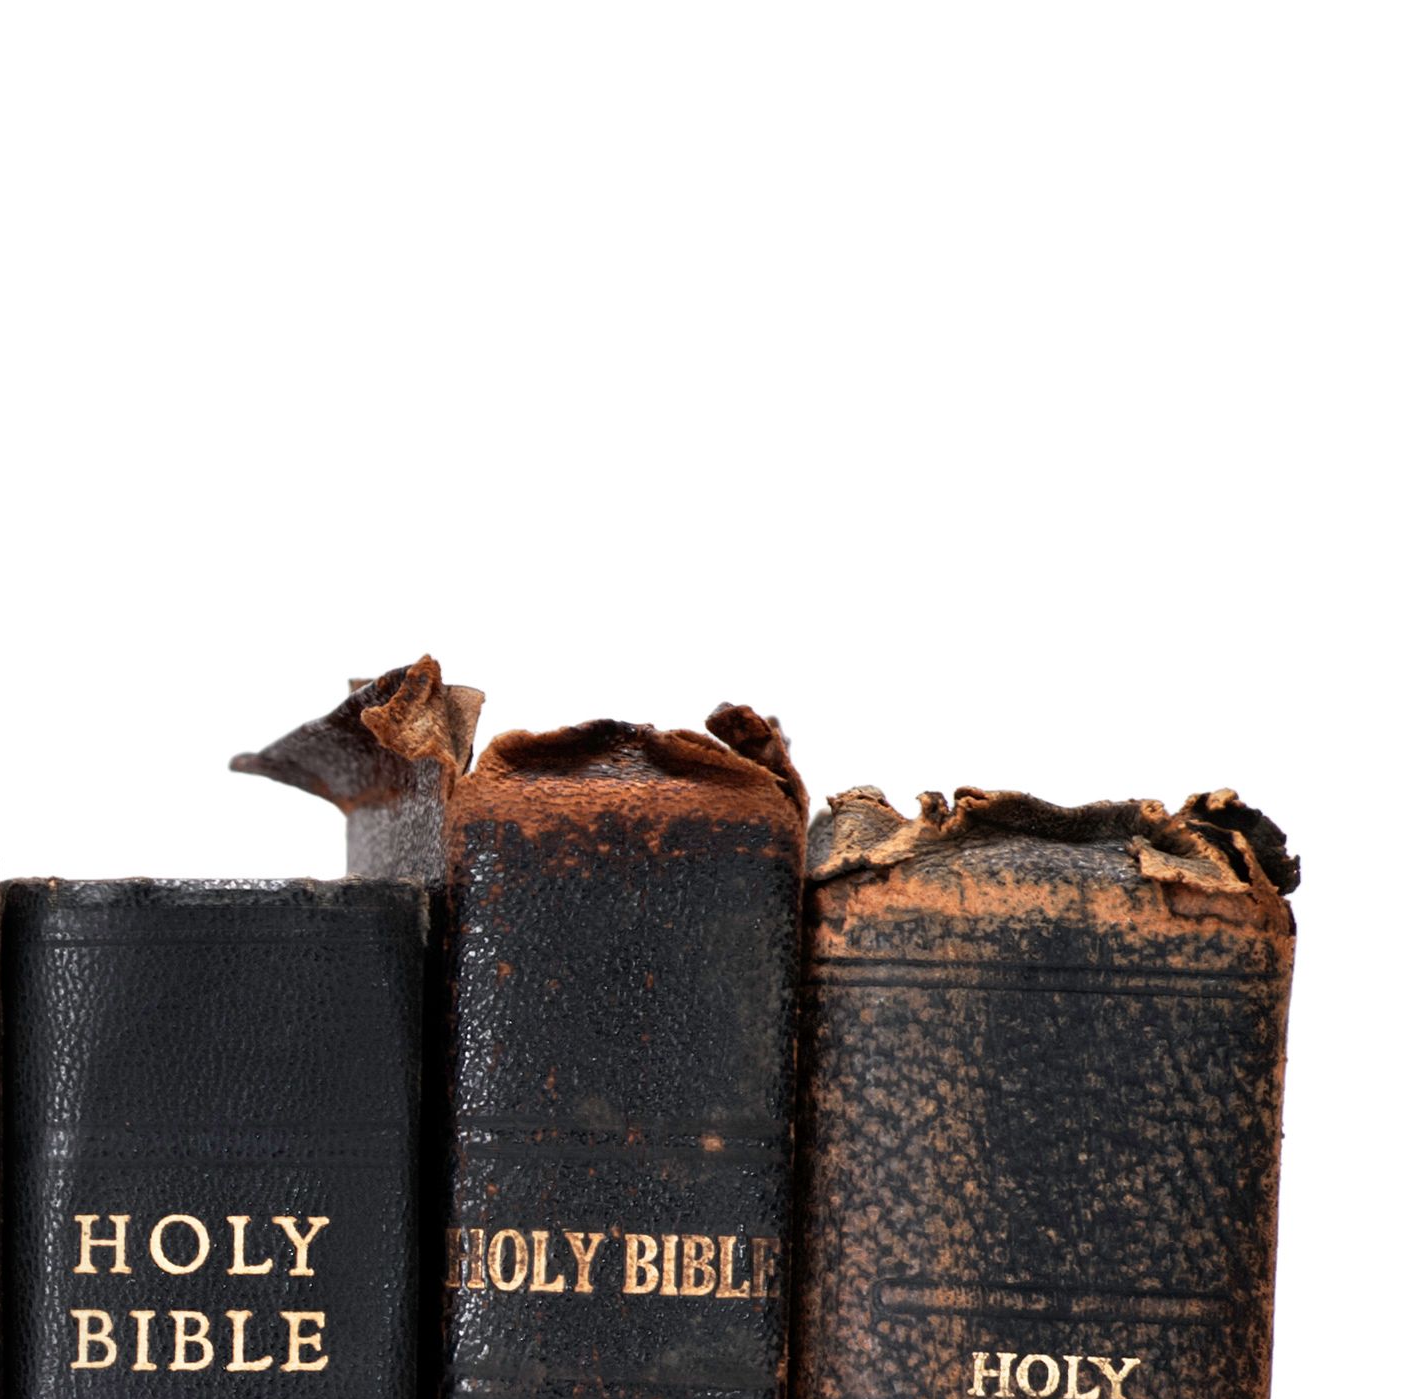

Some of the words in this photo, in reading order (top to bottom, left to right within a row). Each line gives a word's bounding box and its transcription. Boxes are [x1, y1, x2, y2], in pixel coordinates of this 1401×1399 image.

[72, 1214, 330, 1276] HOLY
[446, 1228, 605, 1292] HOLY
[622, 1233, 780, 1298] BIBLE
[70, 1310, 330, 1372] BIBLE
